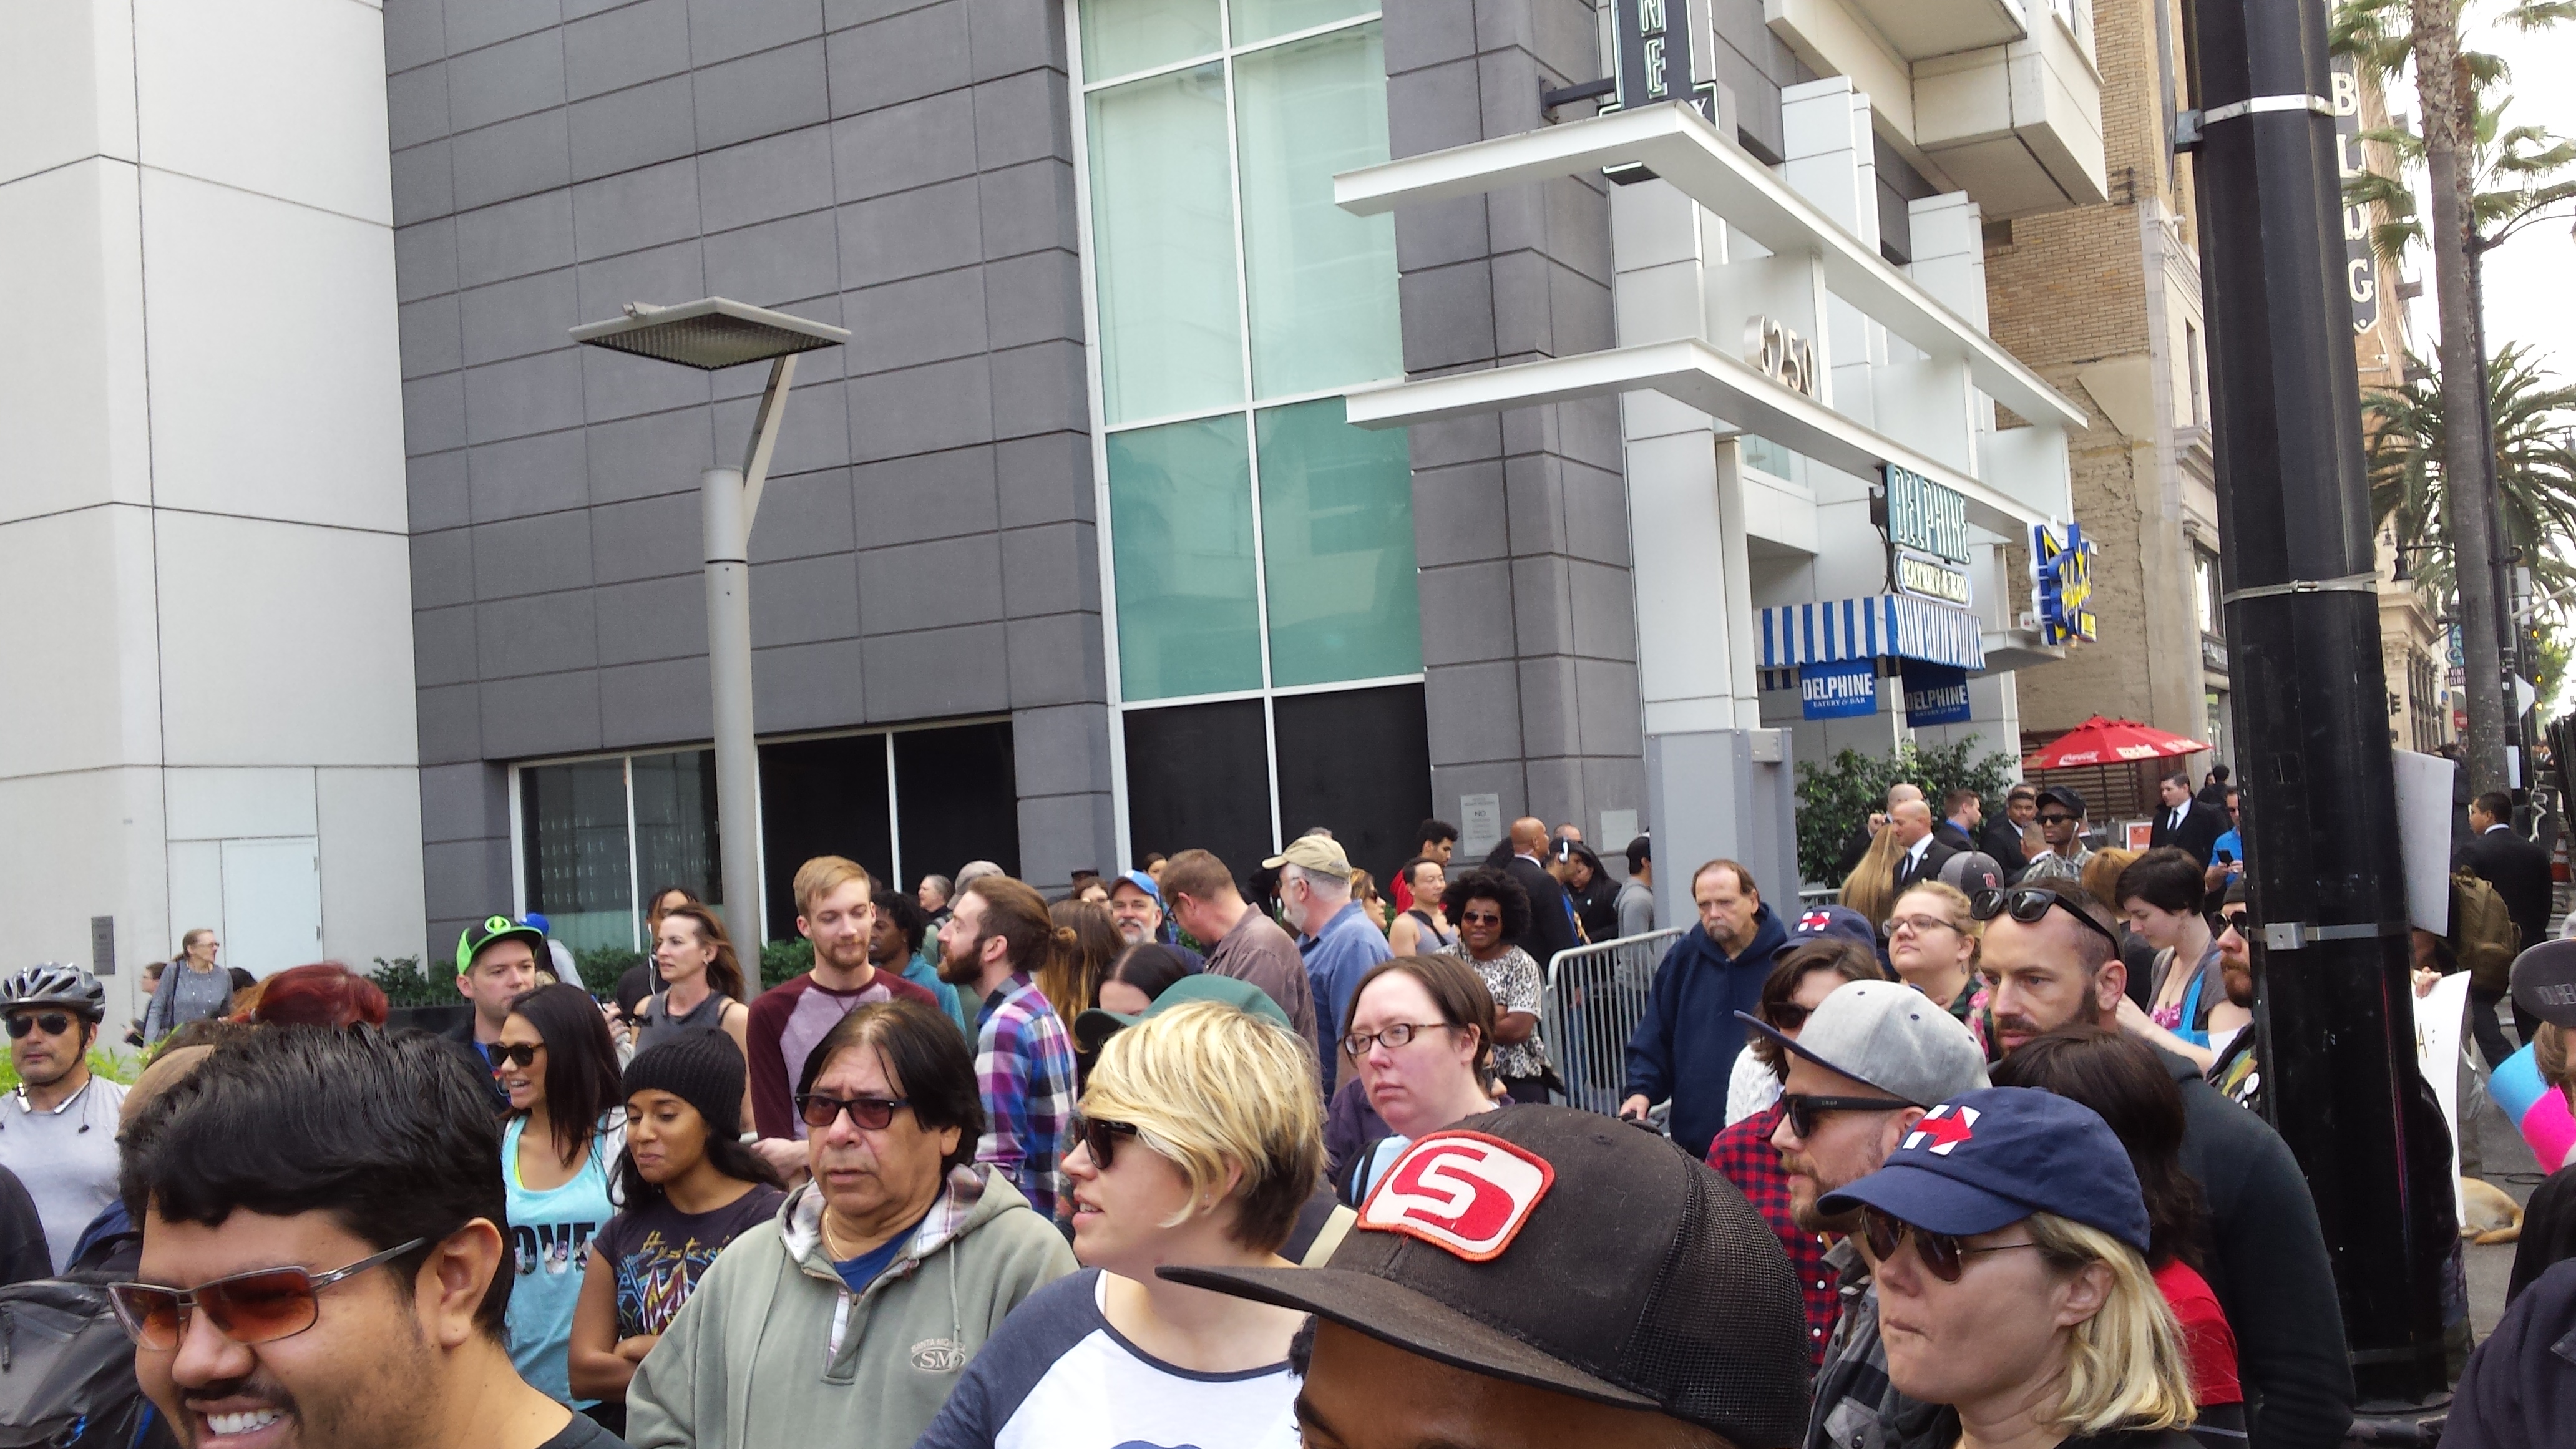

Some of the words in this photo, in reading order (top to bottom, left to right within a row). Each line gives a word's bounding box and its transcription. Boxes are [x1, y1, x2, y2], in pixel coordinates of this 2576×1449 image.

[2333, 70, 2374, 304] BLDG
[1757, 315, 1814, 398] 6250
[1802, 672, 1873, 701] DELPHINE
[1813, 700, 1841, 708] EATERY
[1850, 697, 1866, 705] BAR
[1906, 684, 1968, 711] DELPHINE
[511, 1222, 596, 1276] OVE
